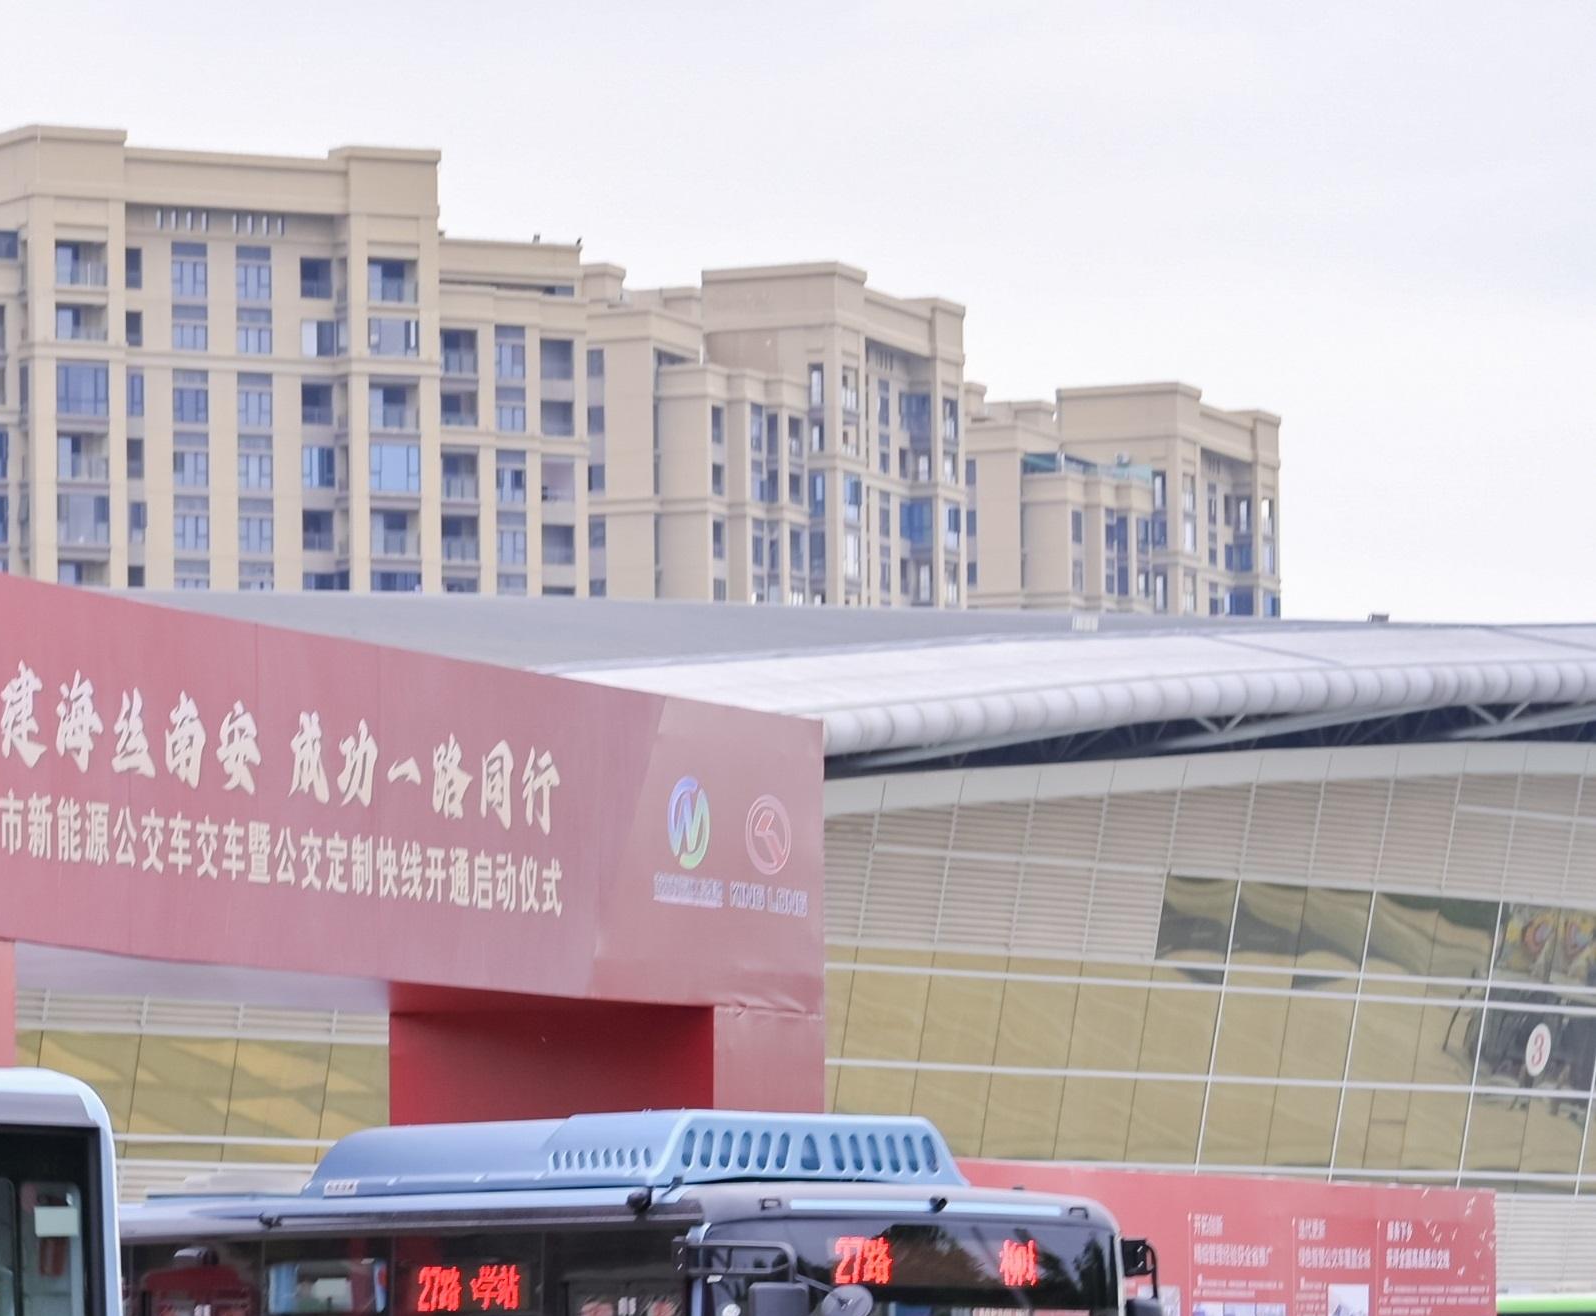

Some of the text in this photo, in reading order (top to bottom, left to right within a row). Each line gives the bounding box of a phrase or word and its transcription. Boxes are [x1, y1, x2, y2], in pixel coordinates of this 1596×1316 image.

[288, 711, 560, 835] 成功一路同行
[1531, 1031, 1545, 1068] 3
[835, 1236, 892, 1284] 27路
[417, 1265, 462, 1312] 27路
